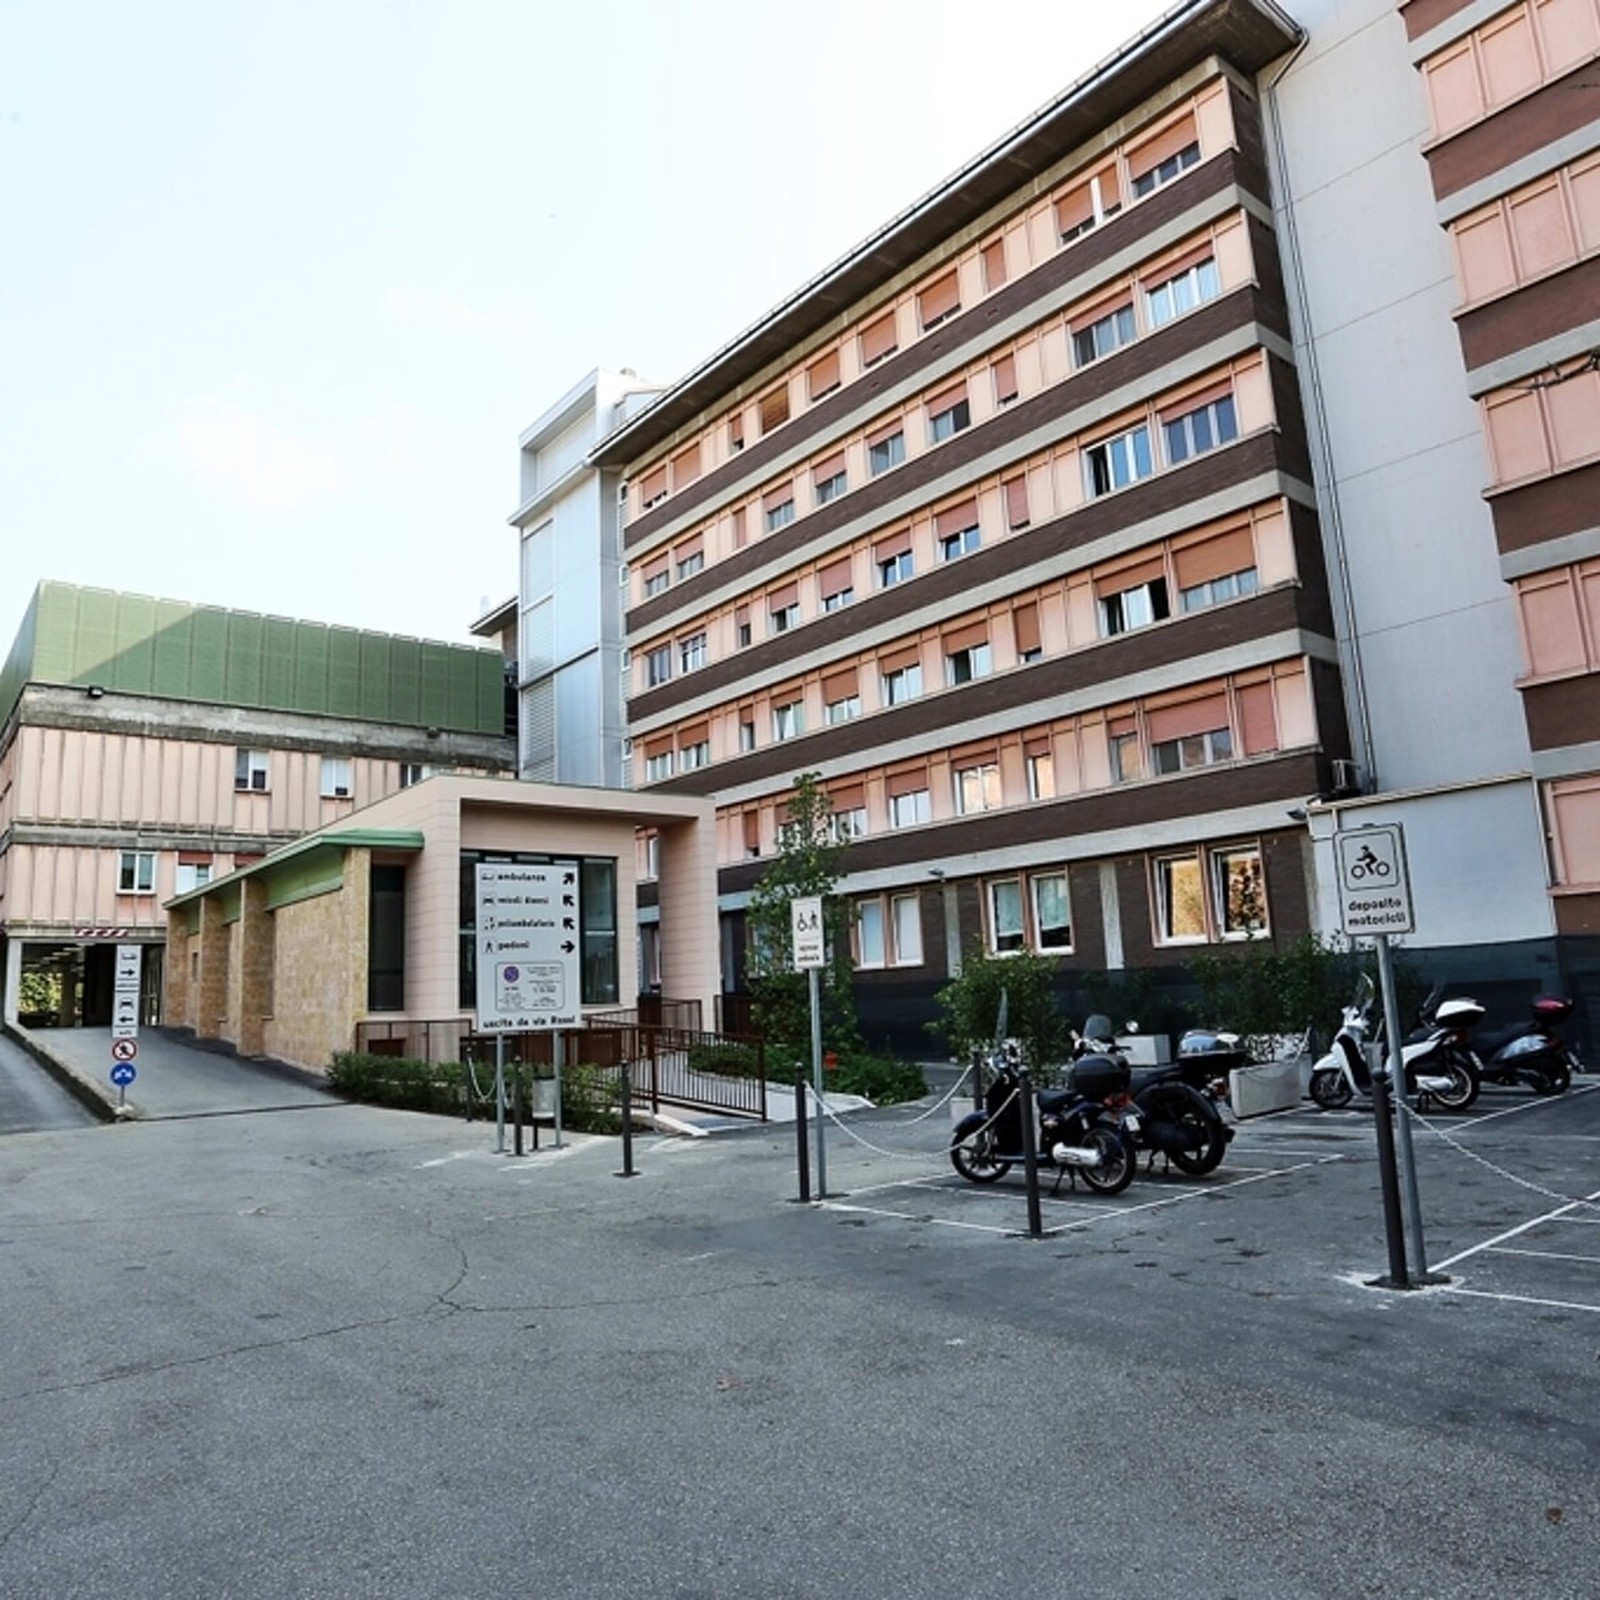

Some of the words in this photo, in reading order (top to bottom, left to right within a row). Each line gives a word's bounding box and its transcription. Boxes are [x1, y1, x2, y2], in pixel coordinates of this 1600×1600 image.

[1348, 897, 1402, 911] deposito
[1348, 912, 1406, 925] motocicli
[498, 941, 530, 951] pedoni
[483, 1019, 512, 1028] uscita
[517, 1018, 529, 1026] da
